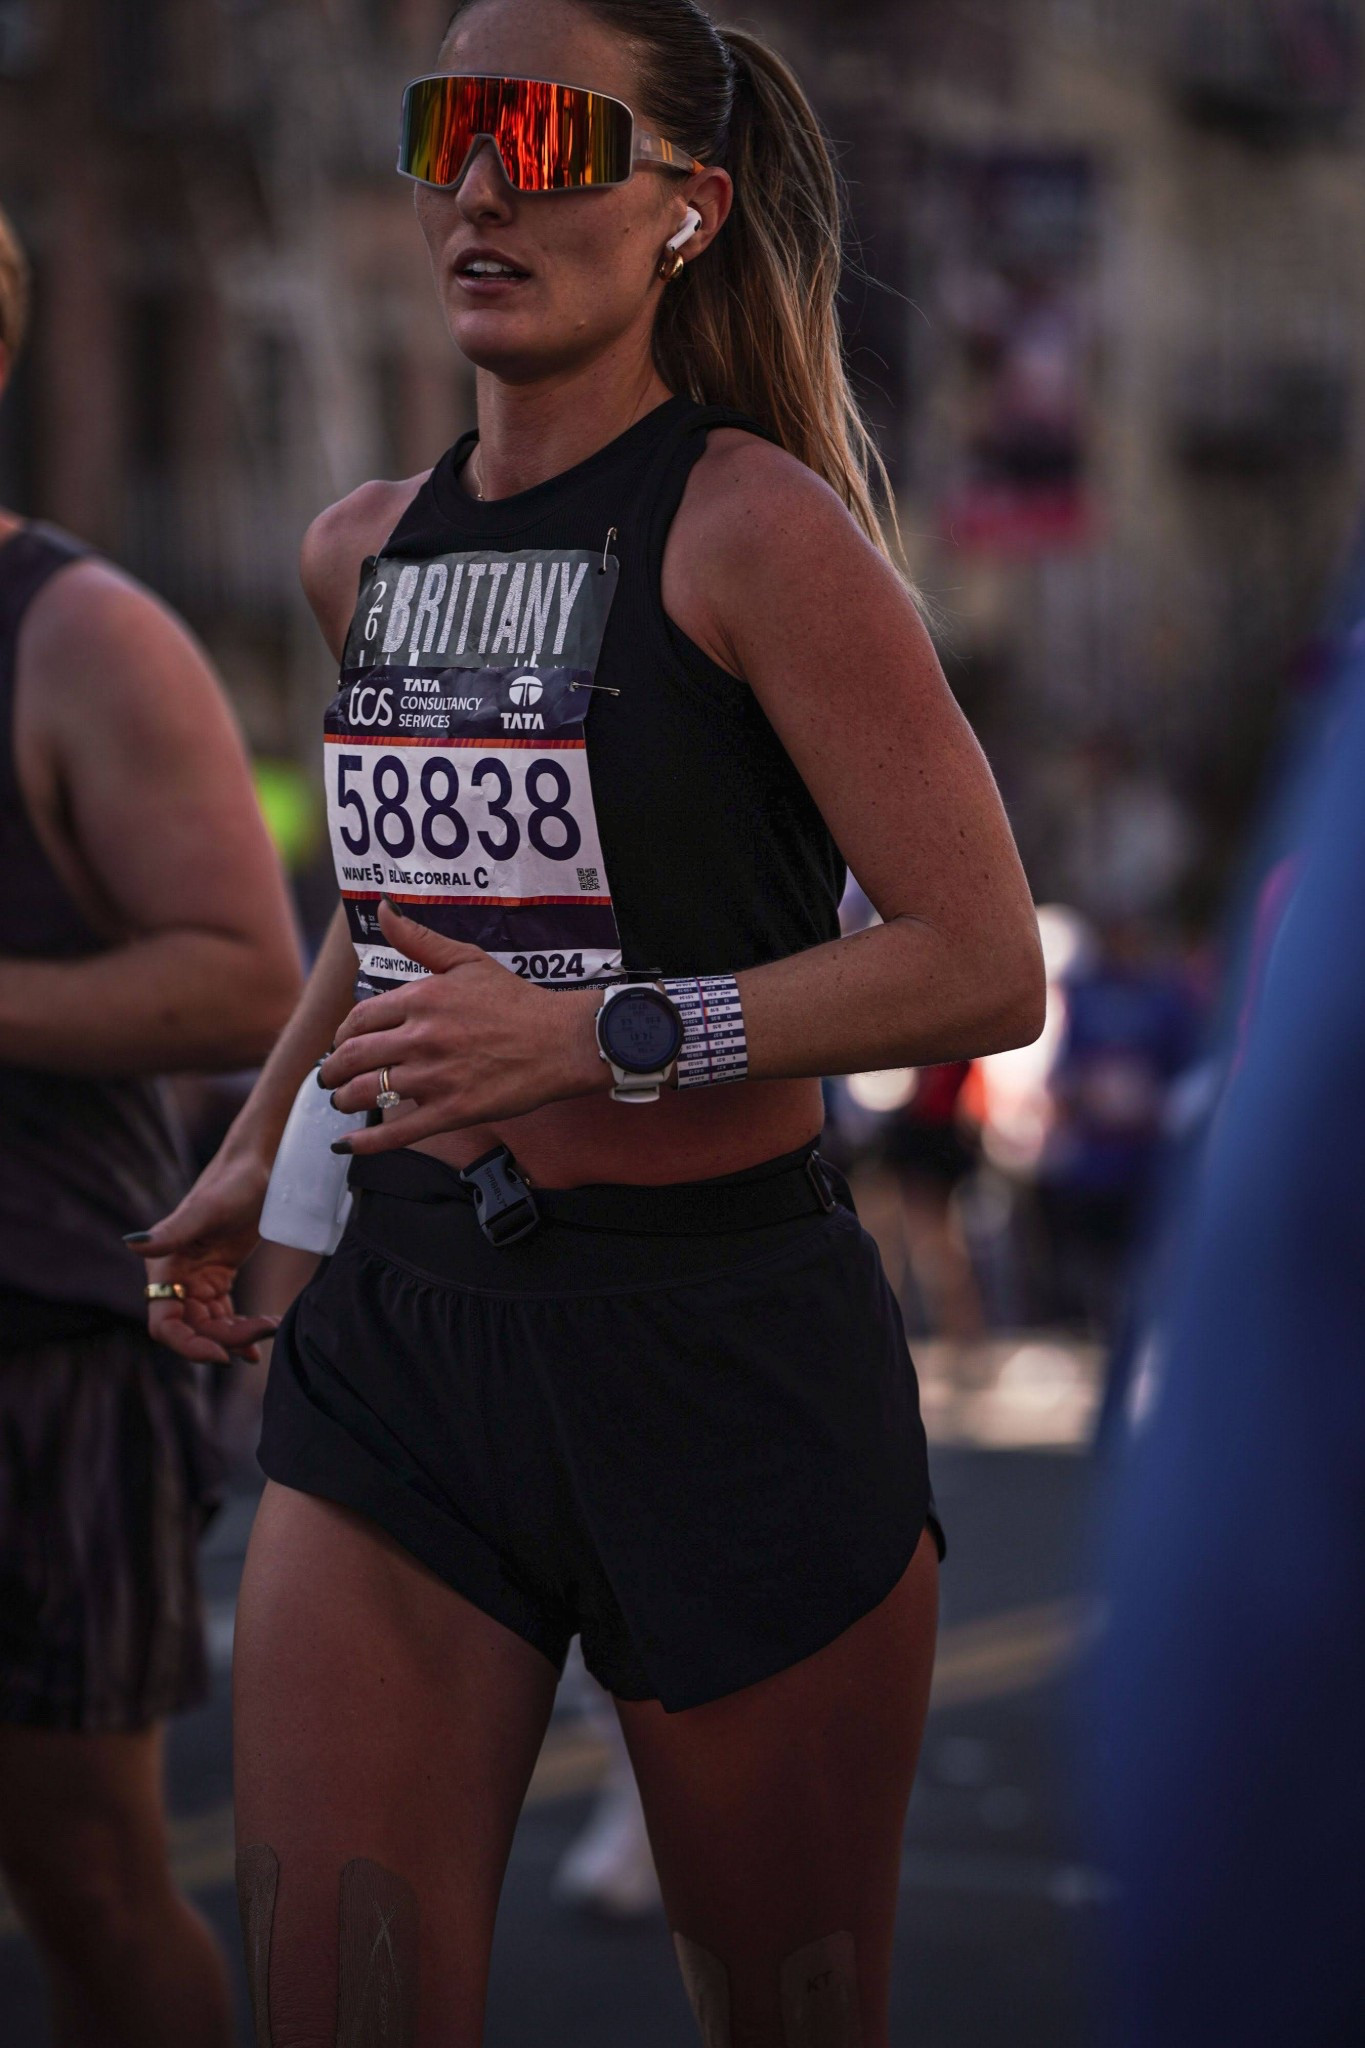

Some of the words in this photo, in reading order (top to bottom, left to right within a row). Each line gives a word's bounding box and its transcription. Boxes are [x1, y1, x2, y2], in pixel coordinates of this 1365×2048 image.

[382, 562, 589, 654] BRITTANY
[403, 678, 440, 692] TATA
[400, 696, 483, 711] CONSULTANCY
[398, 713, 450, 728] SERVICES
[501, 712, 545, 730] TATA
[338, 754, 581, 861] 58838
[342, 867, 373, 881] WAVE
[372, 863, 384, 885] 5
[389, 869, 413, 884] BLUE
[413, 871, 471, 886] CORRAL
[474, 867, 489, 889] C
[511, 952, 585, 979] 2024
